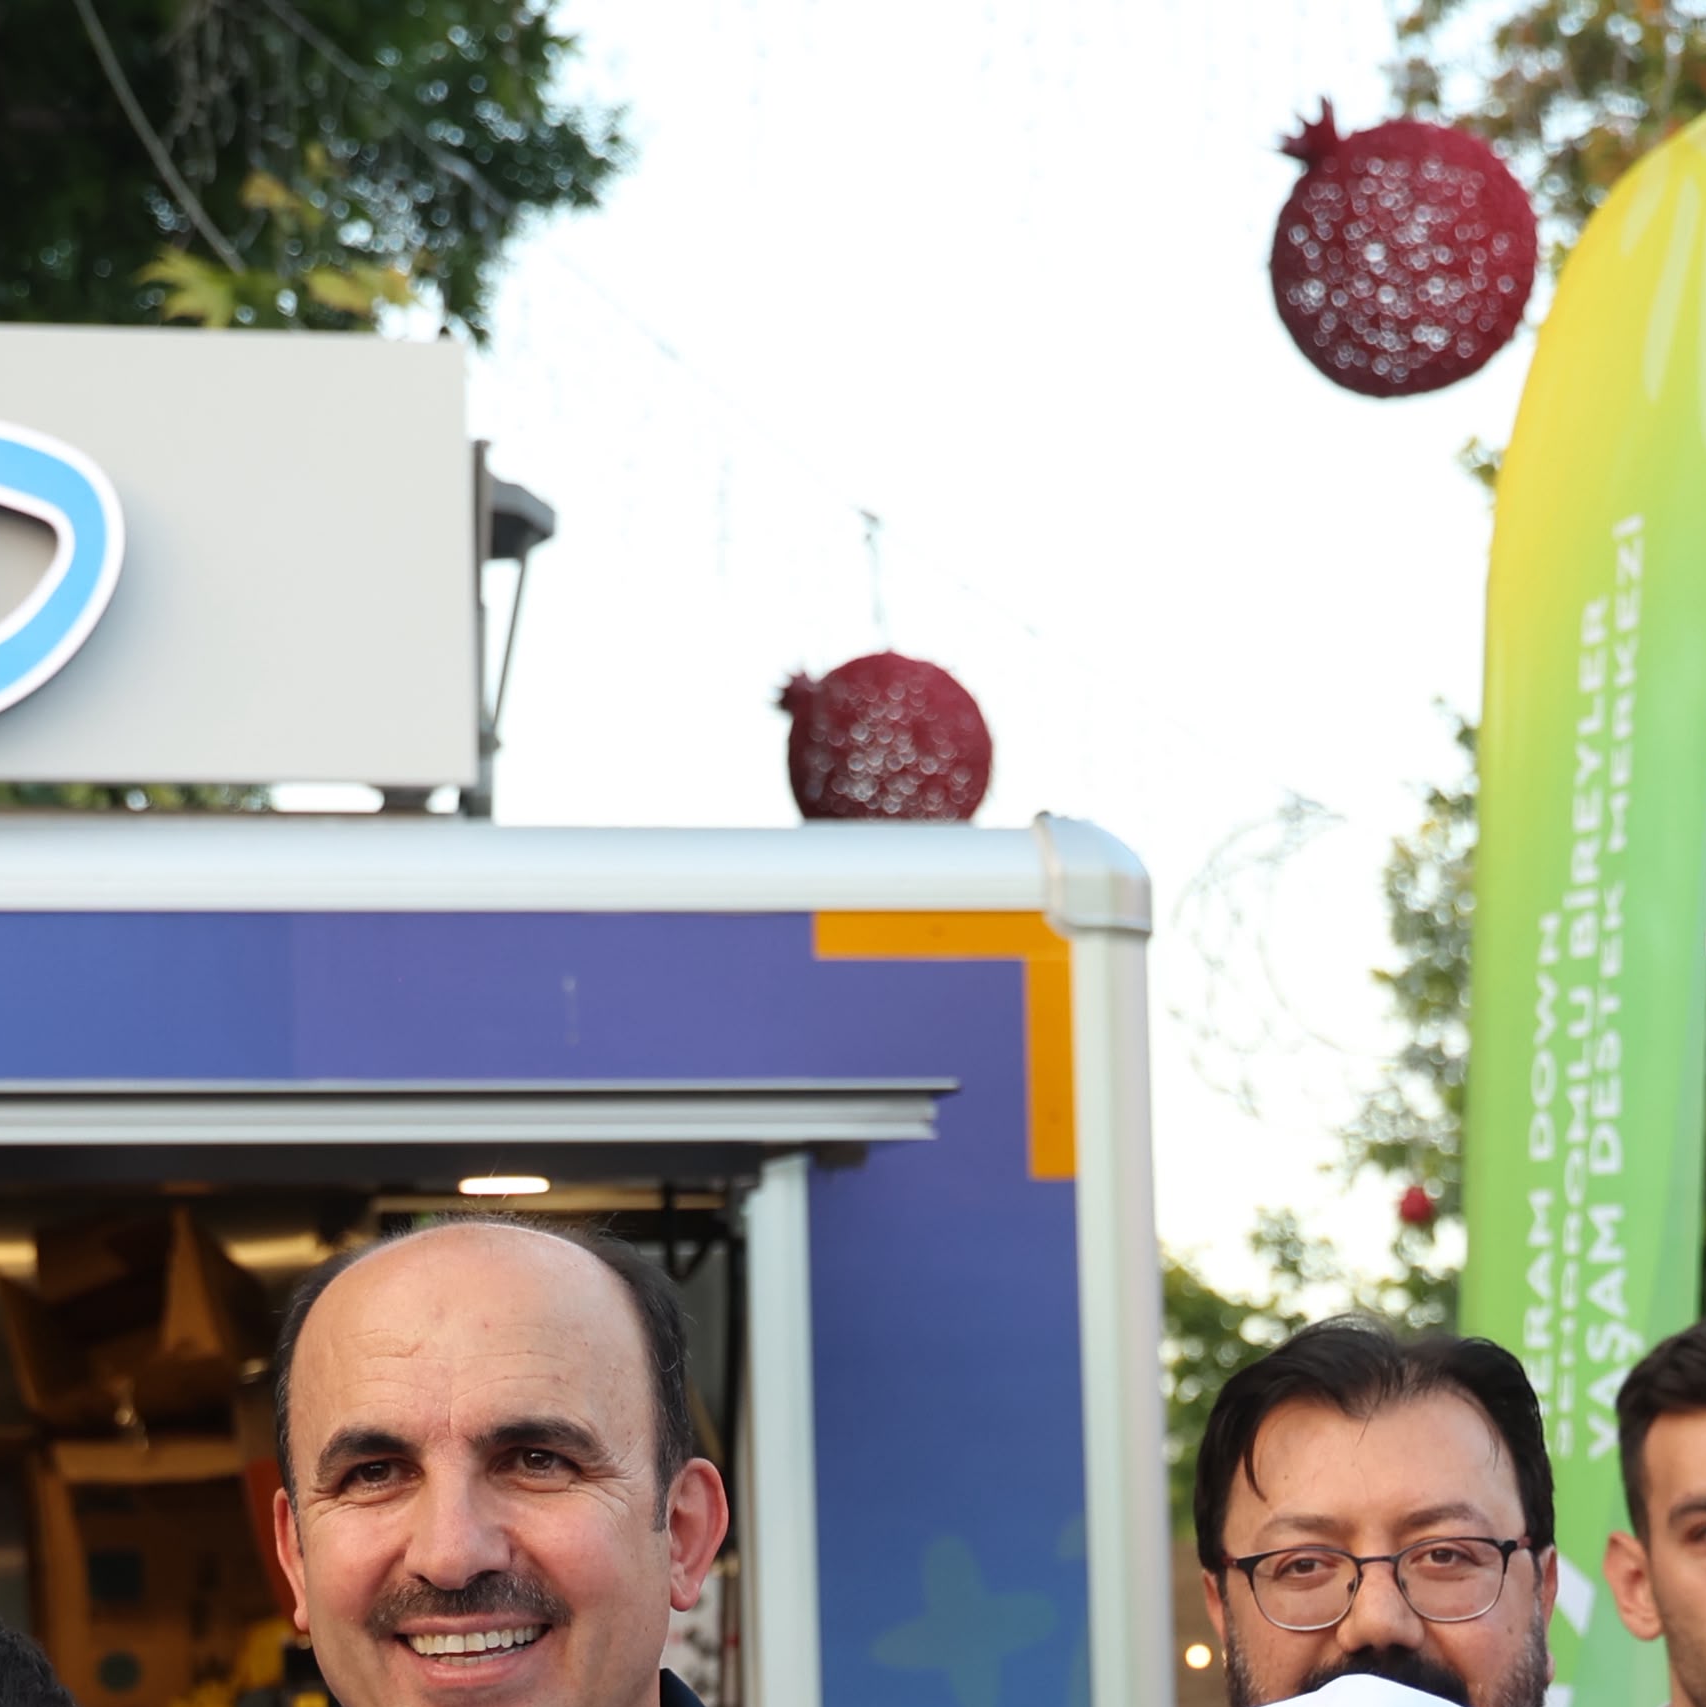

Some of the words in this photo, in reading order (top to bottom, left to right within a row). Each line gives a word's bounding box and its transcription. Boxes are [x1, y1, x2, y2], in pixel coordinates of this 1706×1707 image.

[1563, 596, 1608, 960] BİREYLER
[1607, 513, 1645, 853] MERKEZİ
[1529, 912, 1561, 1162] DOWN
[1589, 882, 1625, 1175] DESTEK
[1554, 986, 1595, 1458] SENDROMLU
[1585, 1204, 1645, 1461] YAŞAM
